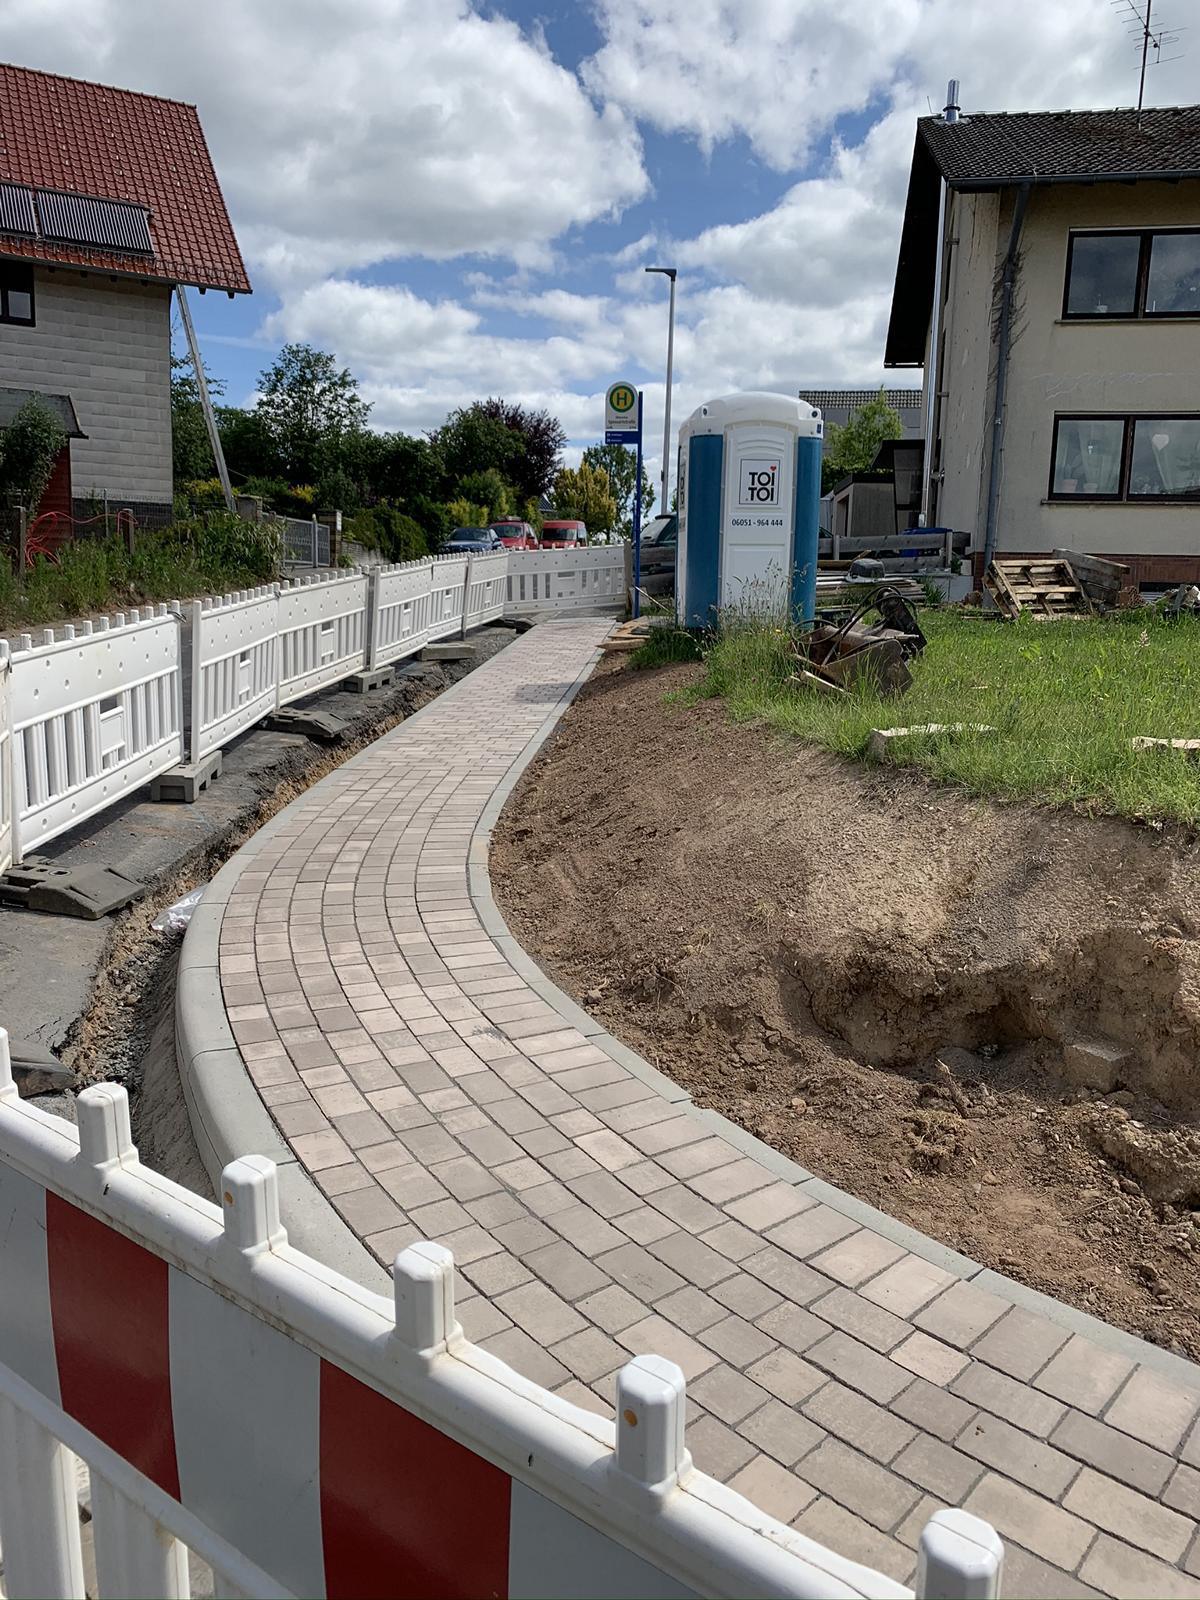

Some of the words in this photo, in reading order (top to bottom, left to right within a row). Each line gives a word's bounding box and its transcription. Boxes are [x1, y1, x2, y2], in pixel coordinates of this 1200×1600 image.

[616, 391, 628, 406] H
[749, 472, 775, 486] TOI
[748, 487, 774, 501] TOI
